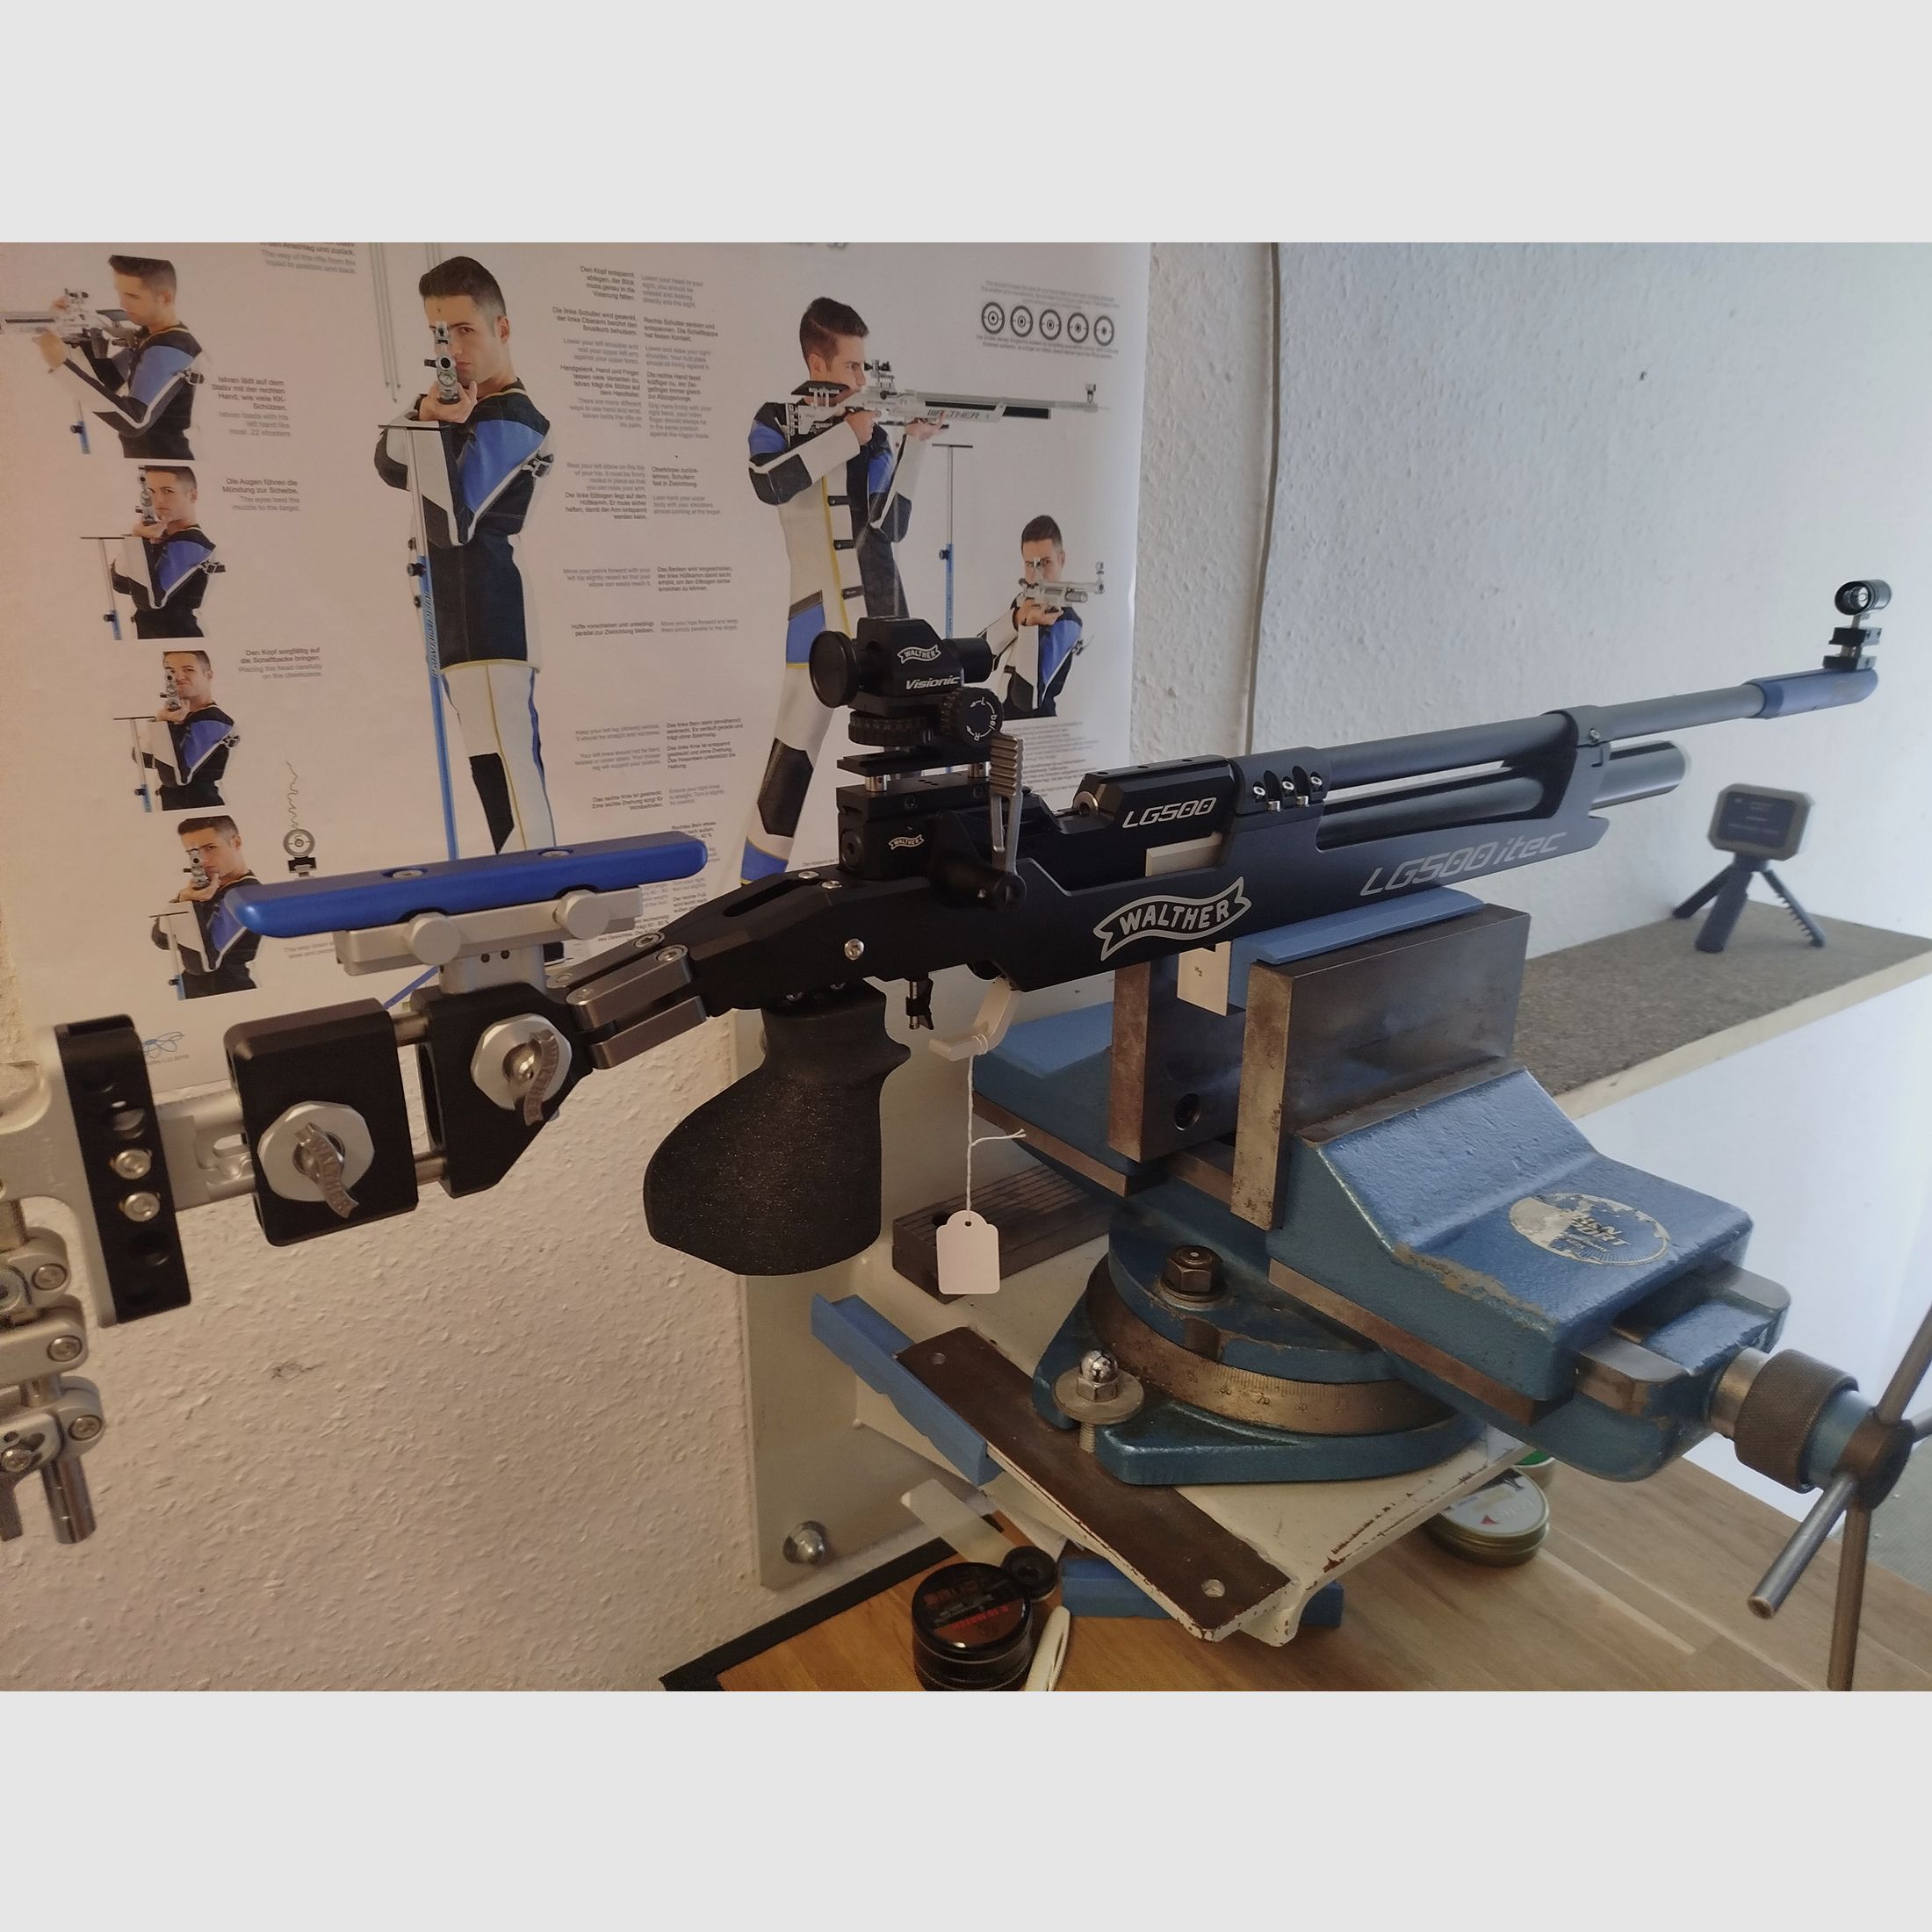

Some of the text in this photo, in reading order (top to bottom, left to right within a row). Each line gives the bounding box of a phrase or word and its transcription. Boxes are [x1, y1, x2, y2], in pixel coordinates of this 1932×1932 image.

[927, 410, 980, 419] WATHER
[906, 675, 960, 690] Visionic
[1122, 797, 1217, 829] LG500
[1120, 899, 1229, 935] WALTHER
